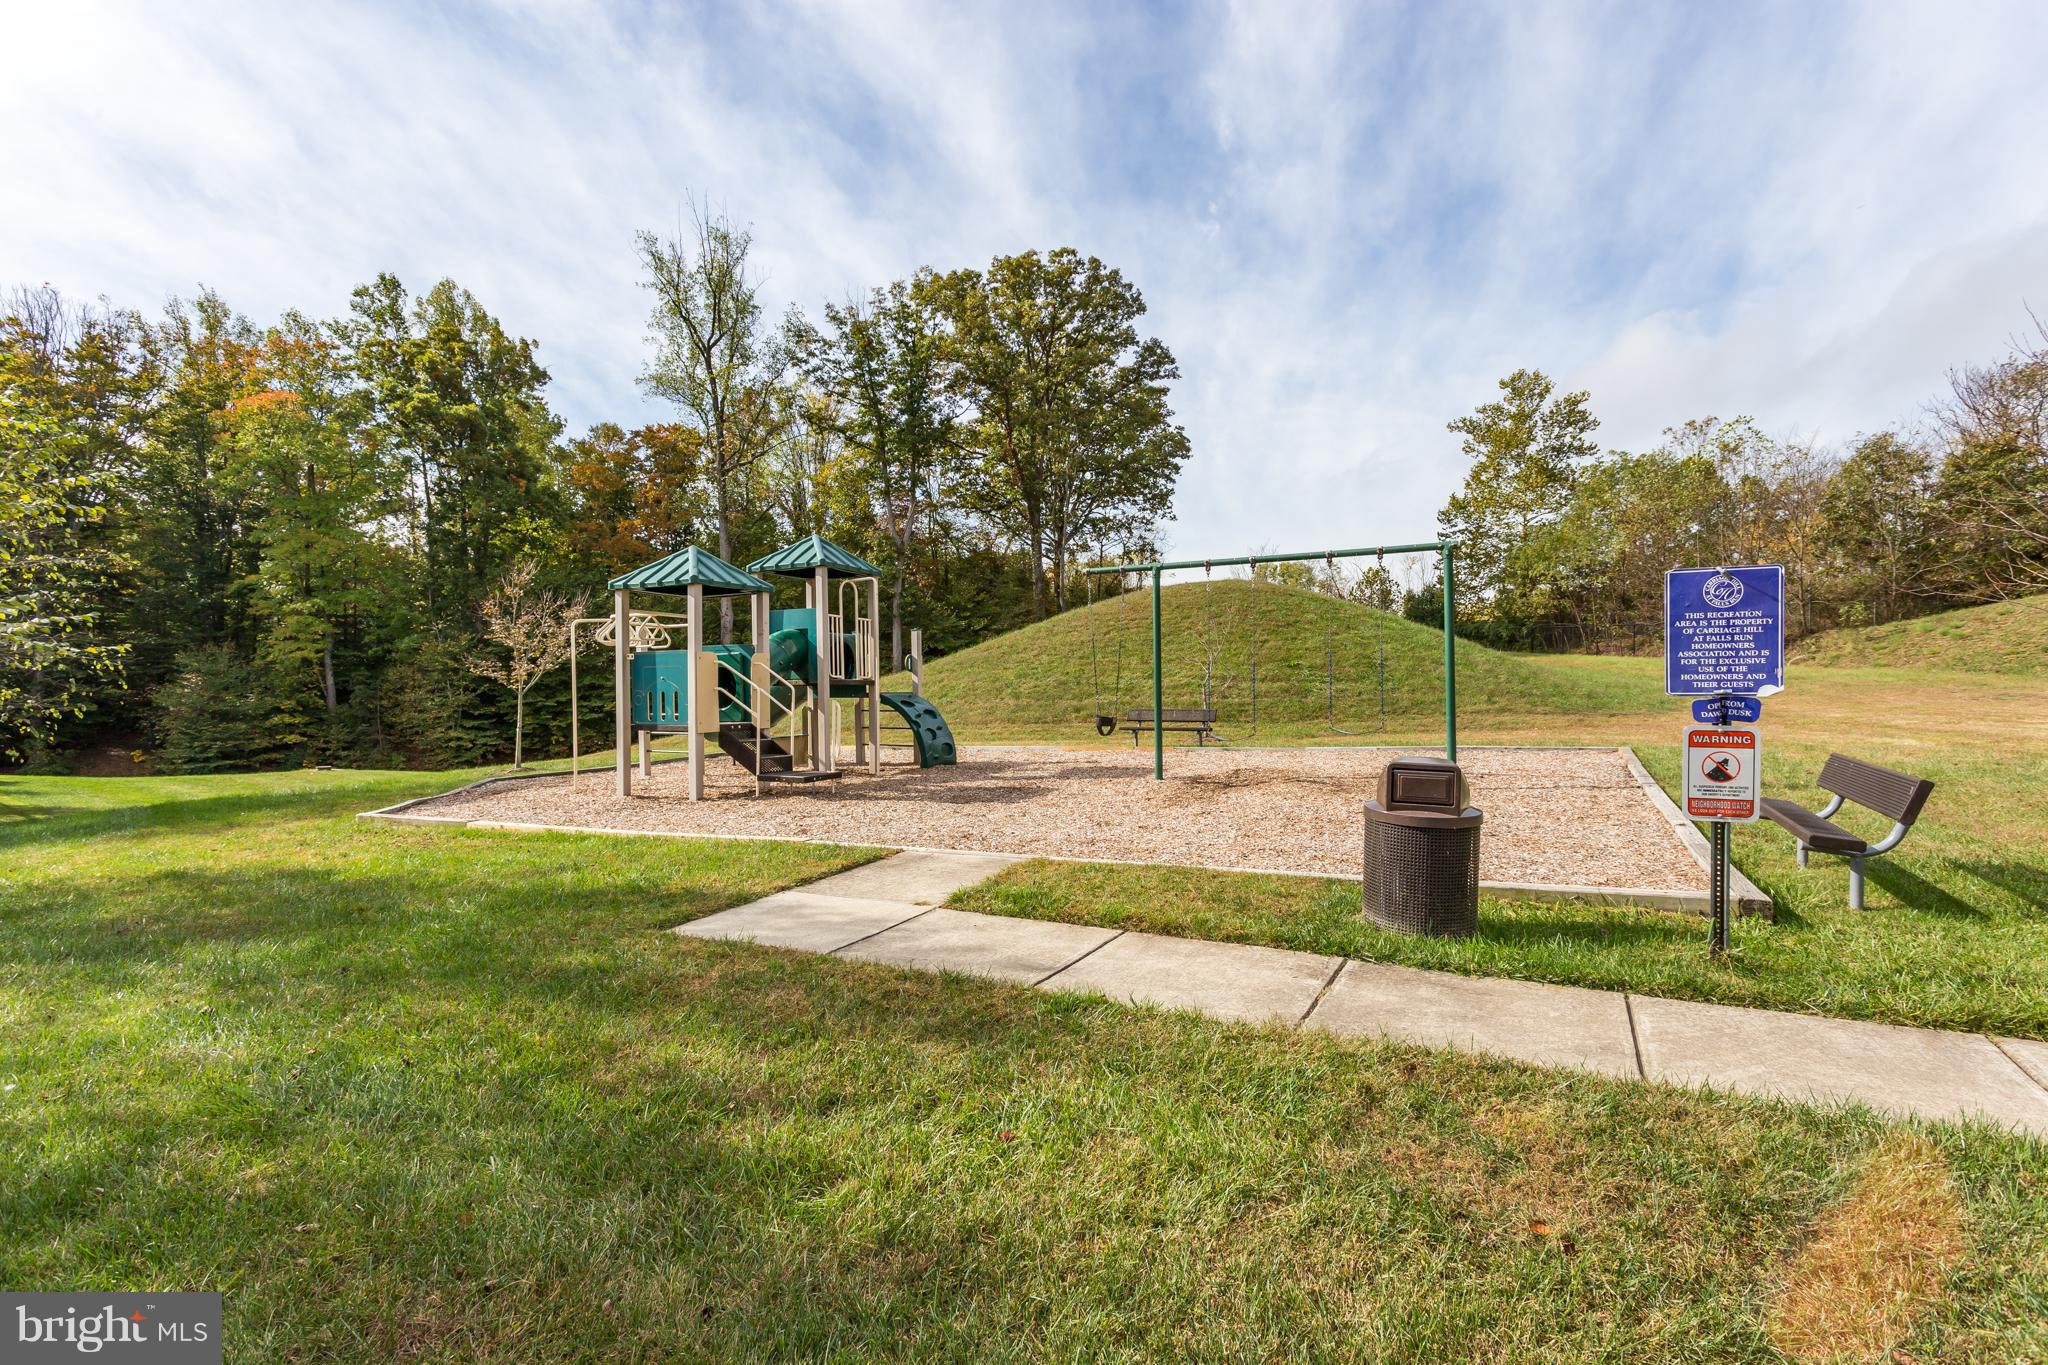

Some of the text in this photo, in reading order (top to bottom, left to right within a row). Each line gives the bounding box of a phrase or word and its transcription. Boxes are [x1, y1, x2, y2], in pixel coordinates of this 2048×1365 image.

[1707, 610, 1762, 618] RECREATION
[1721, 700, 1745, 708] FROM
[1728, 709, 1752, 717] DUSK
[1693, 735, 1751, 744] WARNING
[1692, 800, 1750, 810] NEIGHBORHOOD WATCH
